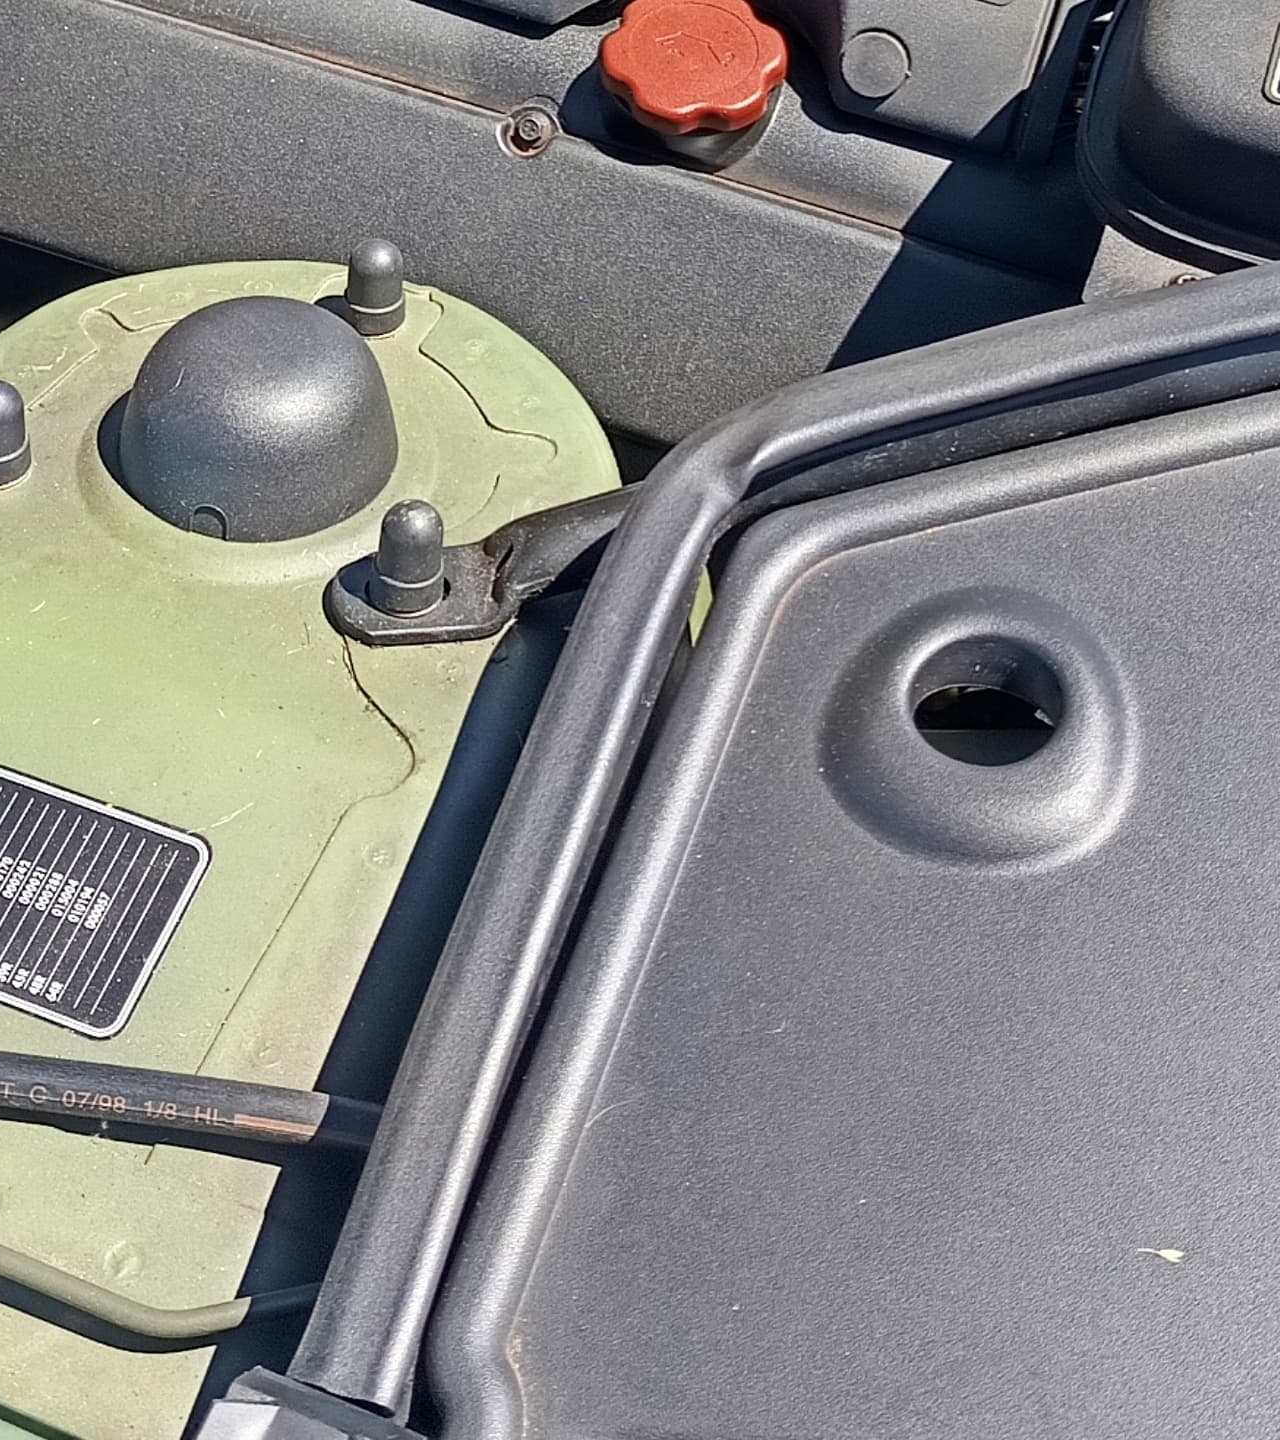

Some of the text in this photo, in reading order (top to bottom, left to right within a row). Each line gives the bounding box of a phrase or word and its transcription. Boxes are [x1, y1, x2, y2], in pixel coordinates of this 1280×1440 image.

[61, 1090, 127, 1114] 07/98
[144, 1099, 178, 1122] 1/8
[194, 1106, 227, 1128] HL
